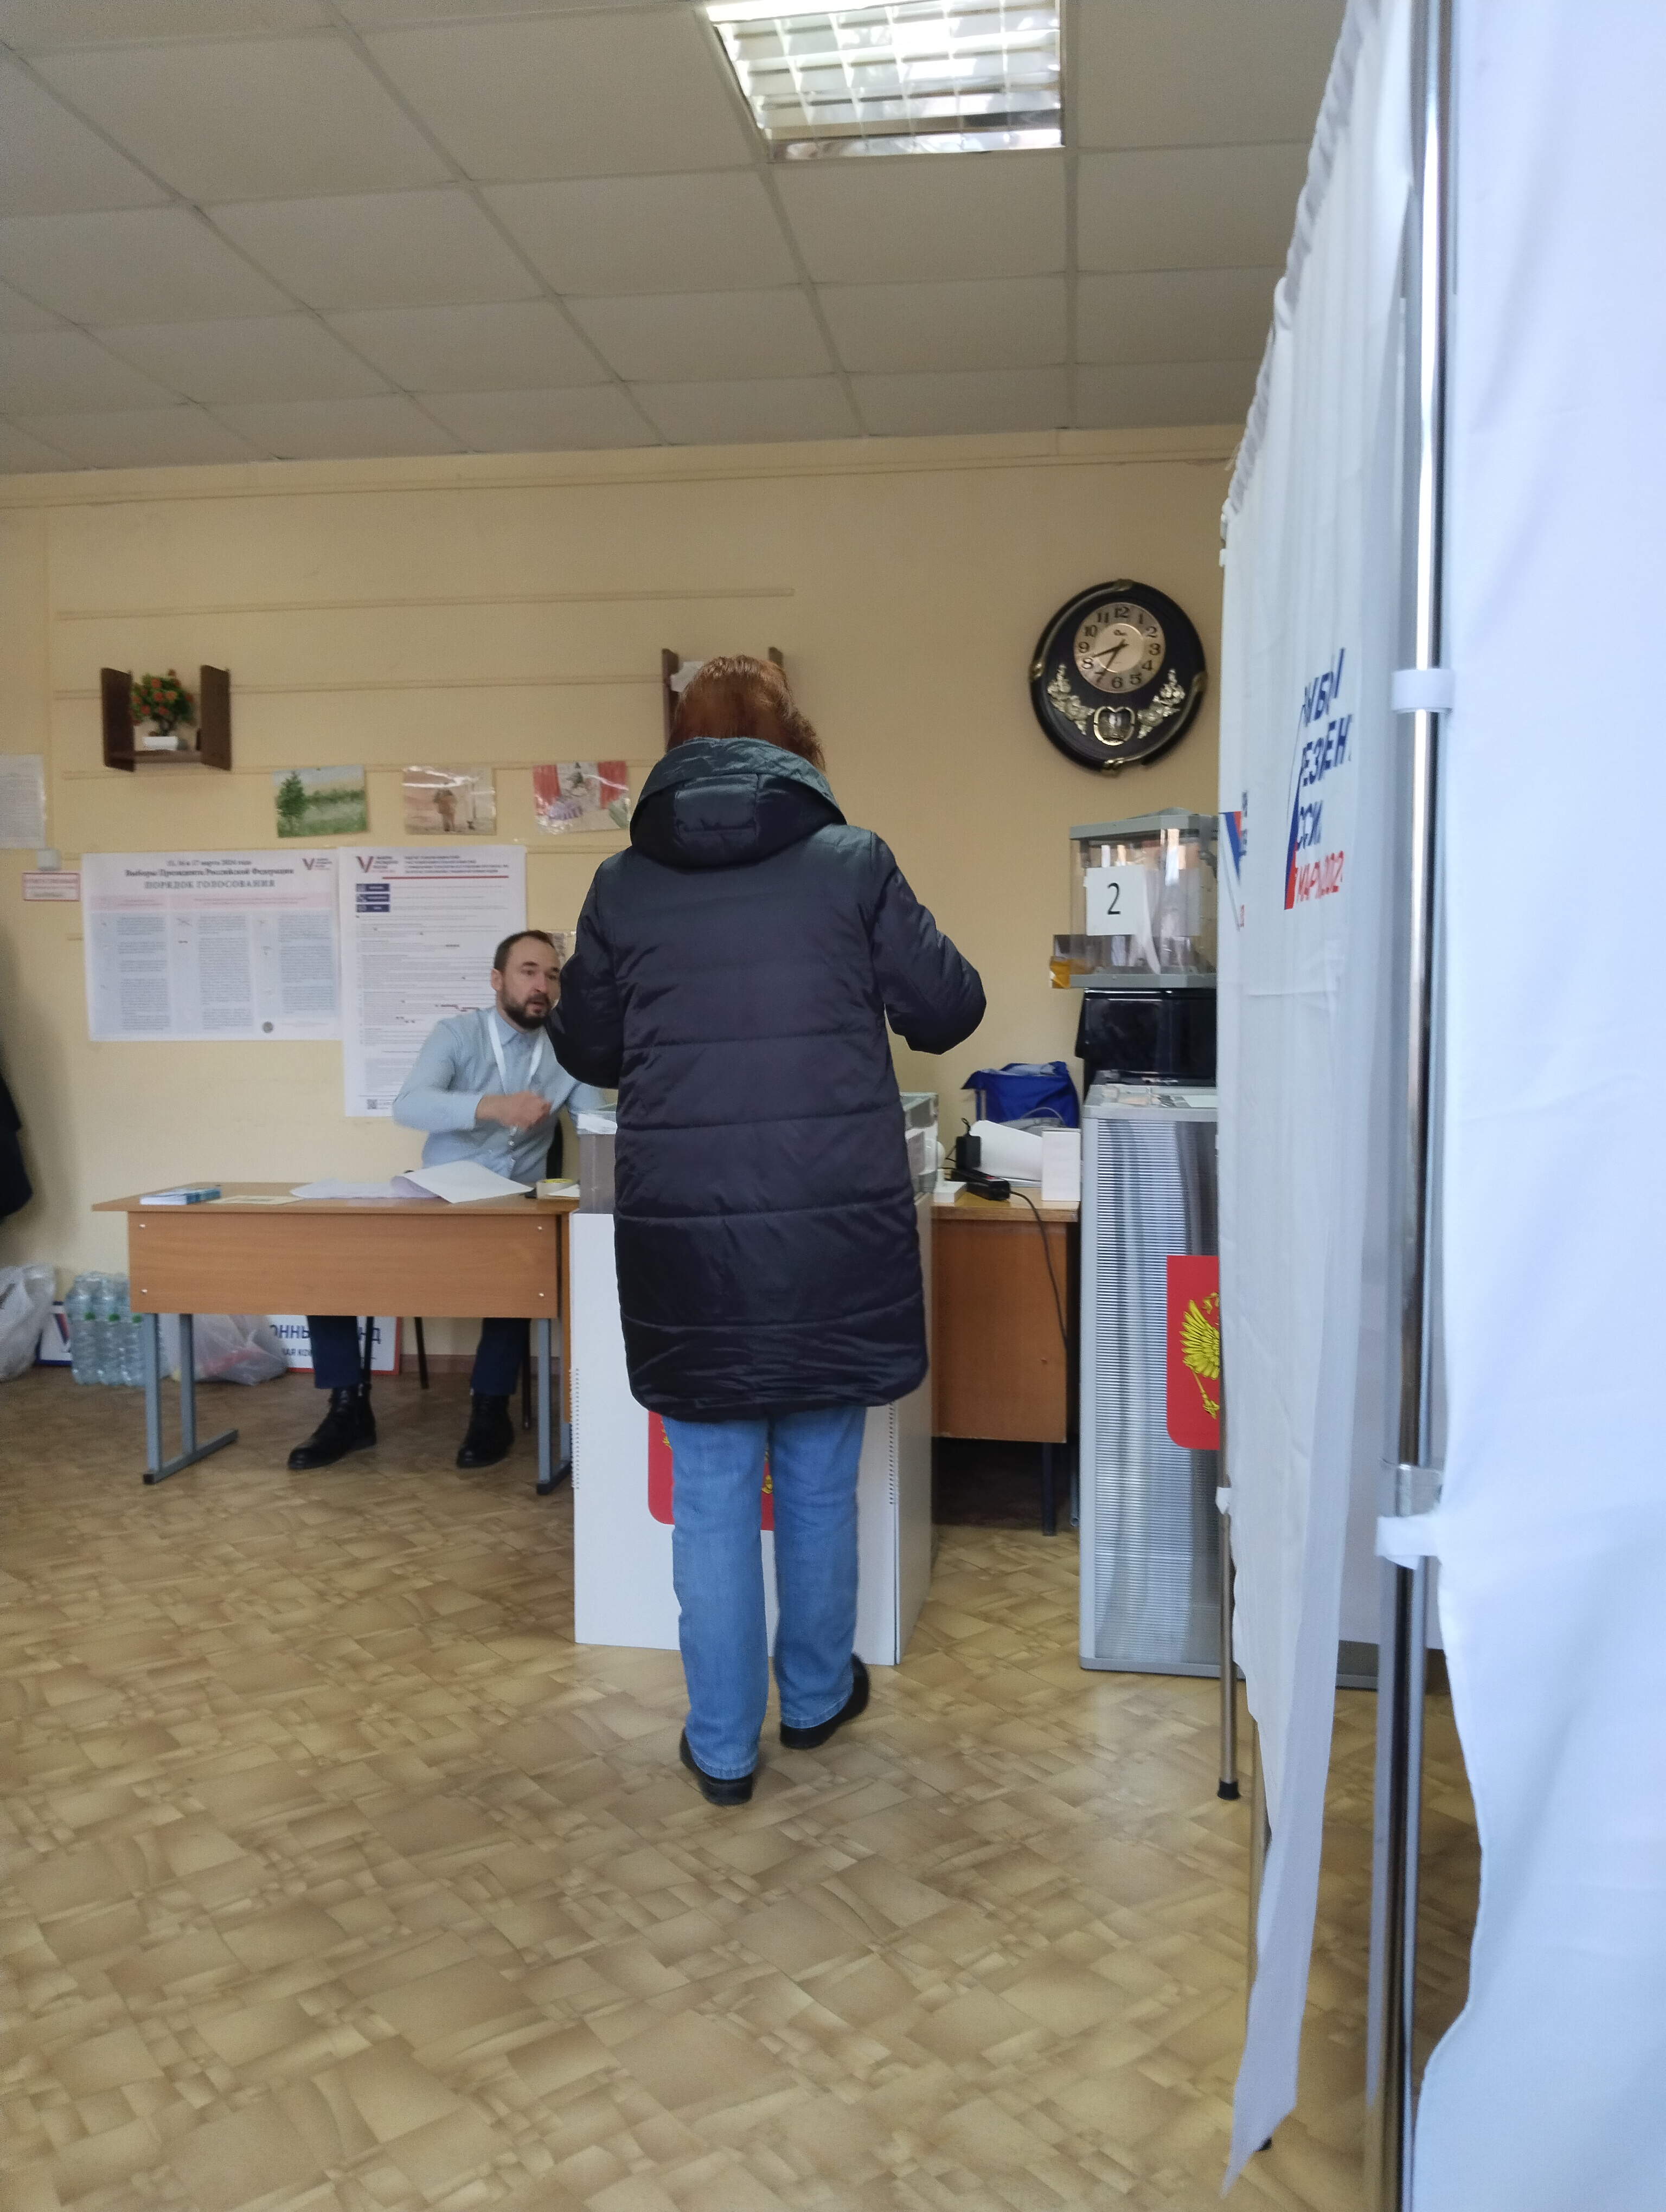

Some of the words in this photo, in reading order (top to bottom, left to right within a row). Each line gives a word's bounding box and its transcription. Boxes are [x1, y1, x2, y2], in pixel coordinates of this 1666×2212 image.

[1098, 612, 1109, 623] 11
[1114, 607, 1130, 618] 12
[1139, 613, 1143, 624] 1
[1085, 625, 1098, 637] 10
[1146, 626, 1157, 638] 2
[1079, 641, 1089, 653] 9
[1149, 643, 1160, 655] 3
[1082, 658, 1093, 669] 8
[1142, 660, 1153, 671] 4
[1112, 677, 1123, 689] 6
[1130, 673, 1142, 685] 5
[144, 880, 194, 889] ПОРЯДОК
[196, 879, 275, 888] ГОЛОСОВАНИЯ
[1107, 882, 1121, 915] 2
